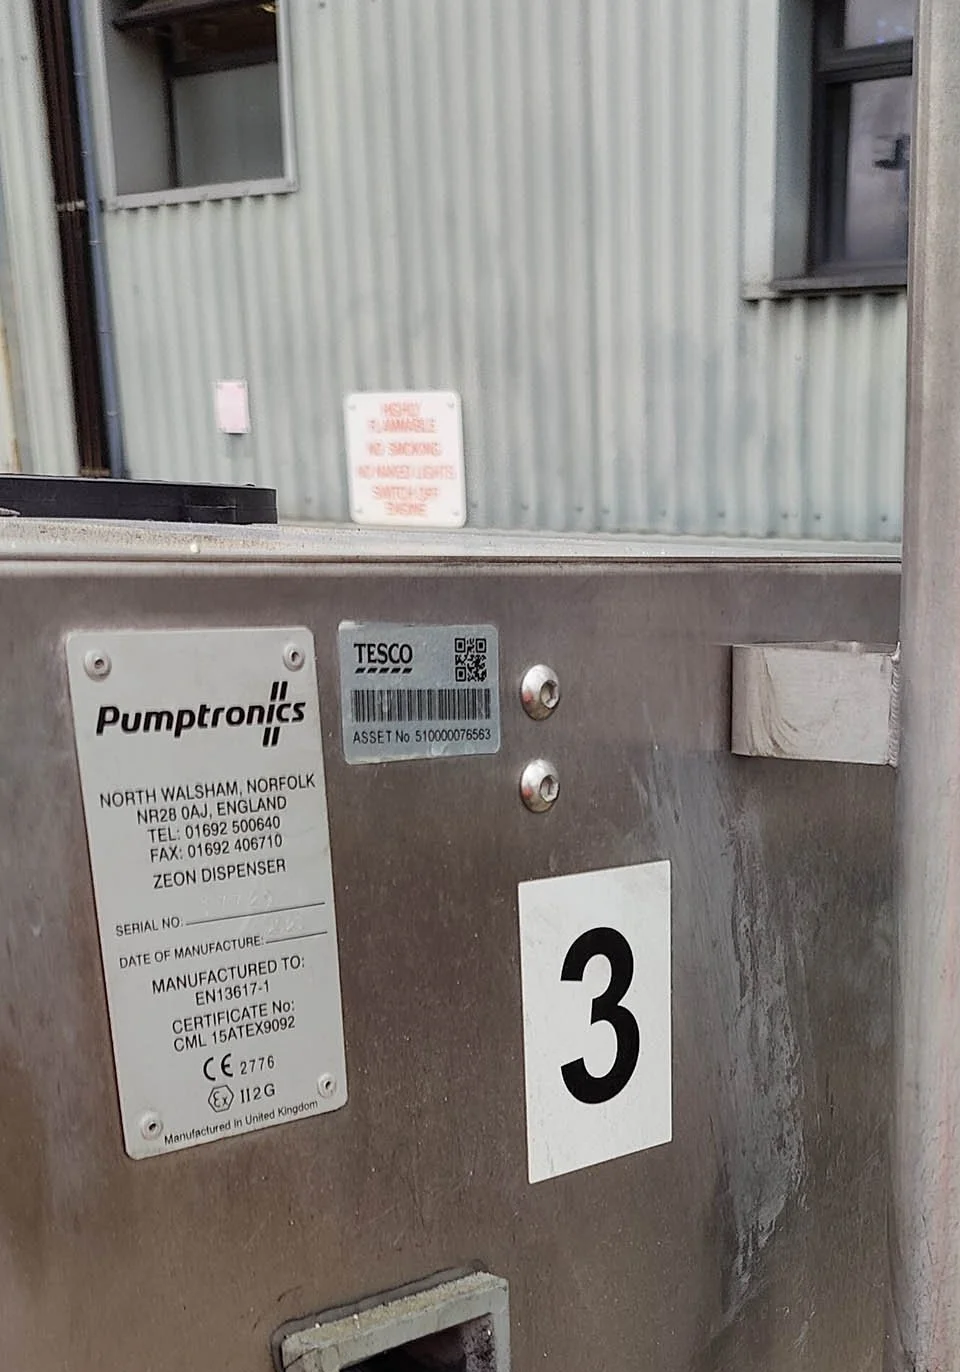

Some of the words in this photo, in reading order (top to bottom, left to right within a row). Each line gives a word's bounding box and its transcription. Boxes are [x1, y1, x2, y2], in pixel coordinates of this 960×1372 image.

[388, 442, 441, 456] SMOKING
[354, 643, 413, 664] TESCO
[96, 702, 306, 738] Pumptronics
[353, 730, 392, 745] ASSET
[415, 729, 491, 743] 510000076563
[100, 788, 156, 809] NORTH
[161, 780, 243, 802] WALSHAM,
[246, 773, 316, 792] NORFOLK
[137, 806, 177, 825] NR28
[218, 796, 287, 816] ENGLAND
[148, 825, 181, 843] TEL:
[185, 820, 228, 840] 01692
[232, 816, 280, 835] 500640
[150, 844, 183, 863] FAX:
[188, 839, 230, 858] 01692
[234, 834, 282, 853] 406710
[153, 870, 197, 889] ZEON
[202, 858, 286, 883] DISPENSER
[116, 920, 158, 936] SERIAL
[162, 916, 183, 929] NO:
[119, 953, 151, 969] DATE
[154, 950, 171, 963] OF
[174, 935, 264, 960] MANUFACTURE:
[152, 960, 277, 994] MANUFACTURED
[281, 955, 305, 970] TO:
[195, 980, 271, 1006] EN13617-1
[172, 1004, 268, 1035] CERTIFICATE
[271, 1000, 296, 1015] No:
[560, 927, 640, 1105] 3
[173, 1034, 207, 1053] CML
[212, 1016, 296, 1043] 15ATEX9092
[240, 1055, 275, 1076] 2776
[164, 1119, 231, 1146] Manufactured
[233, 1117, 243, 1129] in
[244, 1109, 275, 1125] United
[277, 1099, 319, 1119] Kingdom
